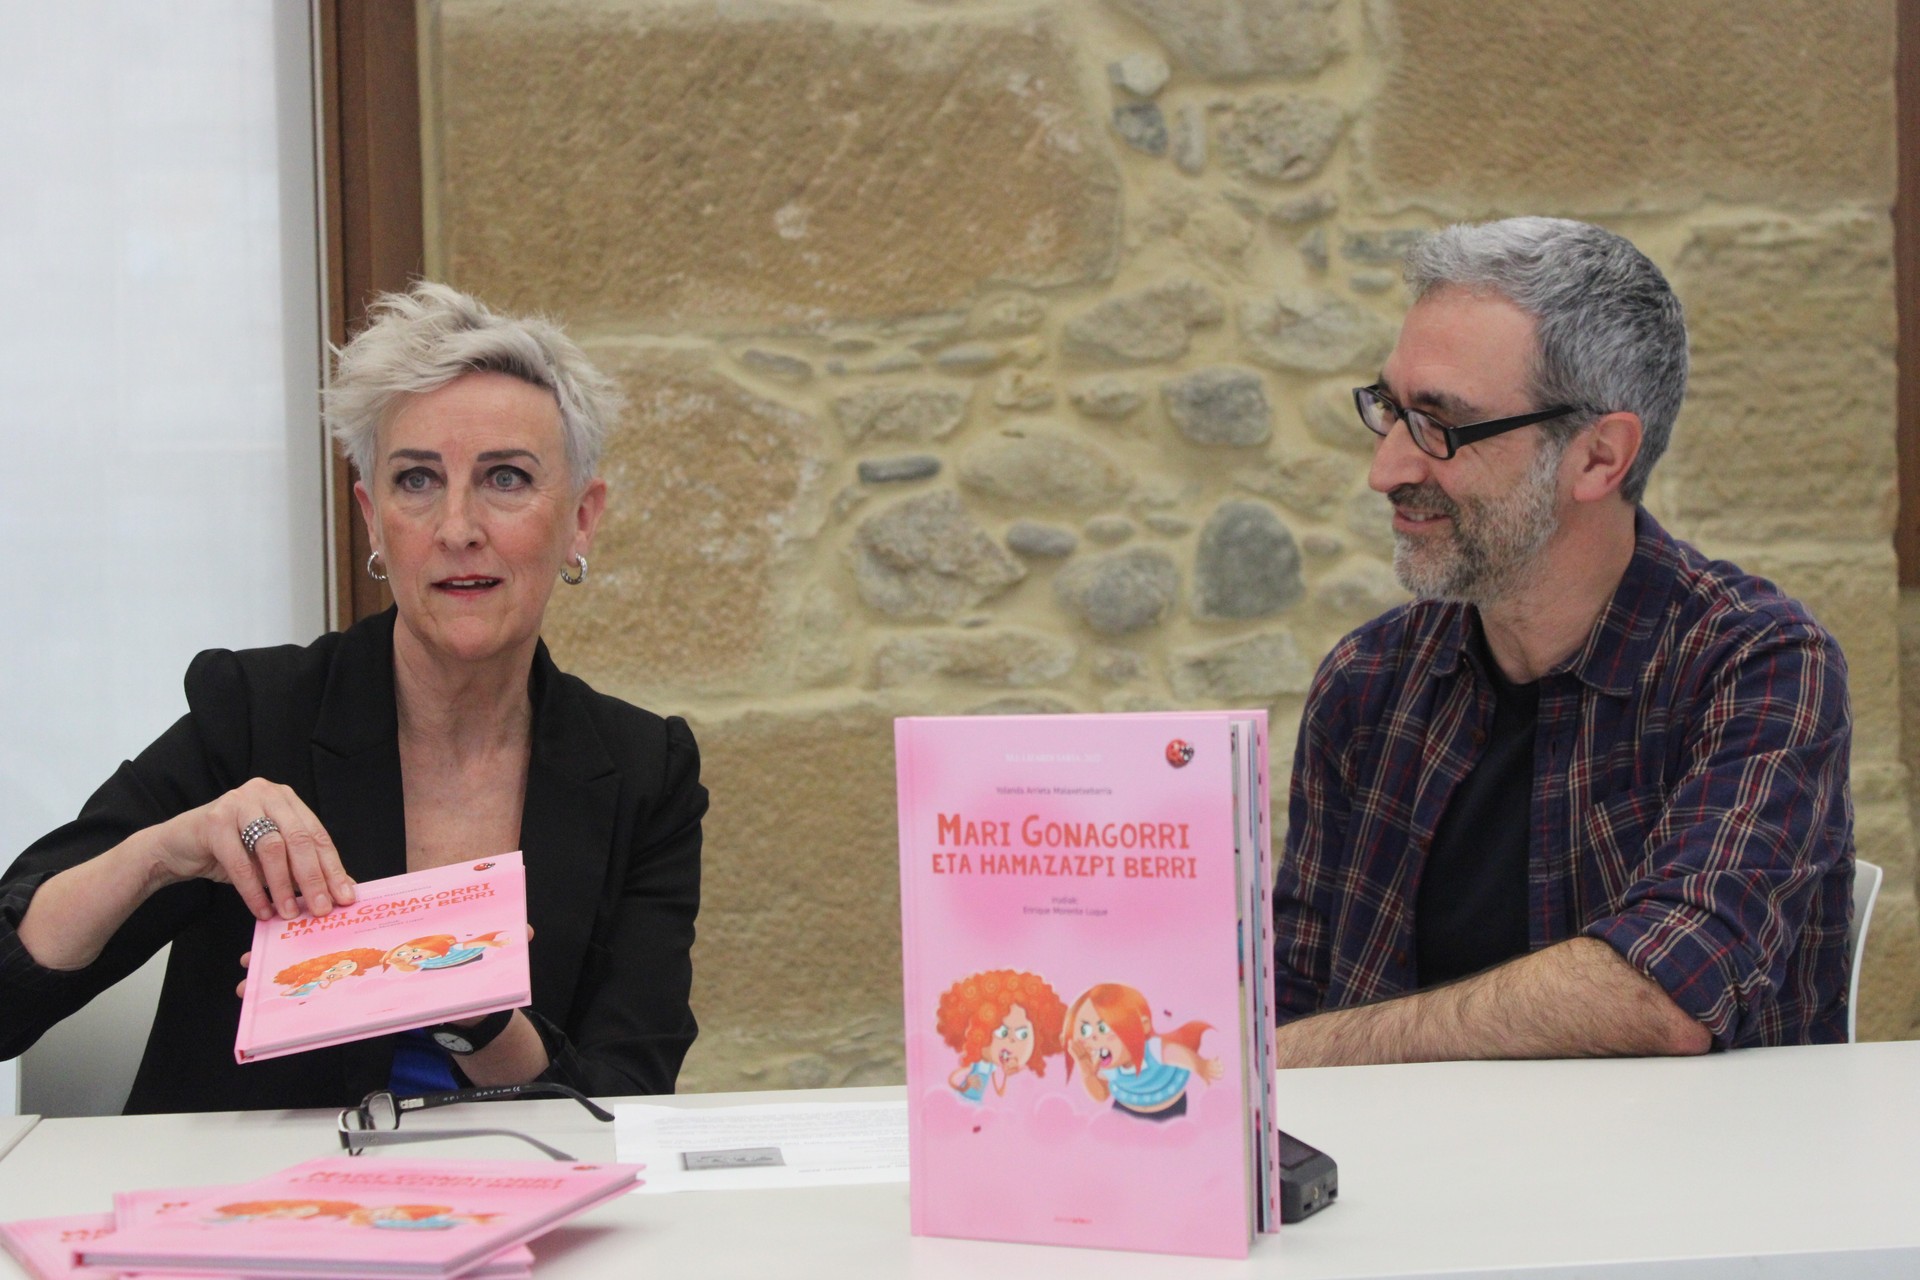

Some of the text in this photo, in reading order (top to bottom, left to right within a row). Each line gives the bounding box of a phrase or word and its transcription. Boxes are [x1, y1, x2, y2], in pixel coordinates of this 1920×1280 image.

[937, 813, 1190, 850] MARI GONAGORRI
[932, 853, 1197, 880] ETA HAMAZAZPI BERRI
[280, 928, 314, 940] ETA
[321, 902, 432, 933] HAMAZAZPI
[437, 889, 496, 908] BERRI
[287, 911, 347, 931] MARI
[356, 882, 491, 916] GONAGORRI
